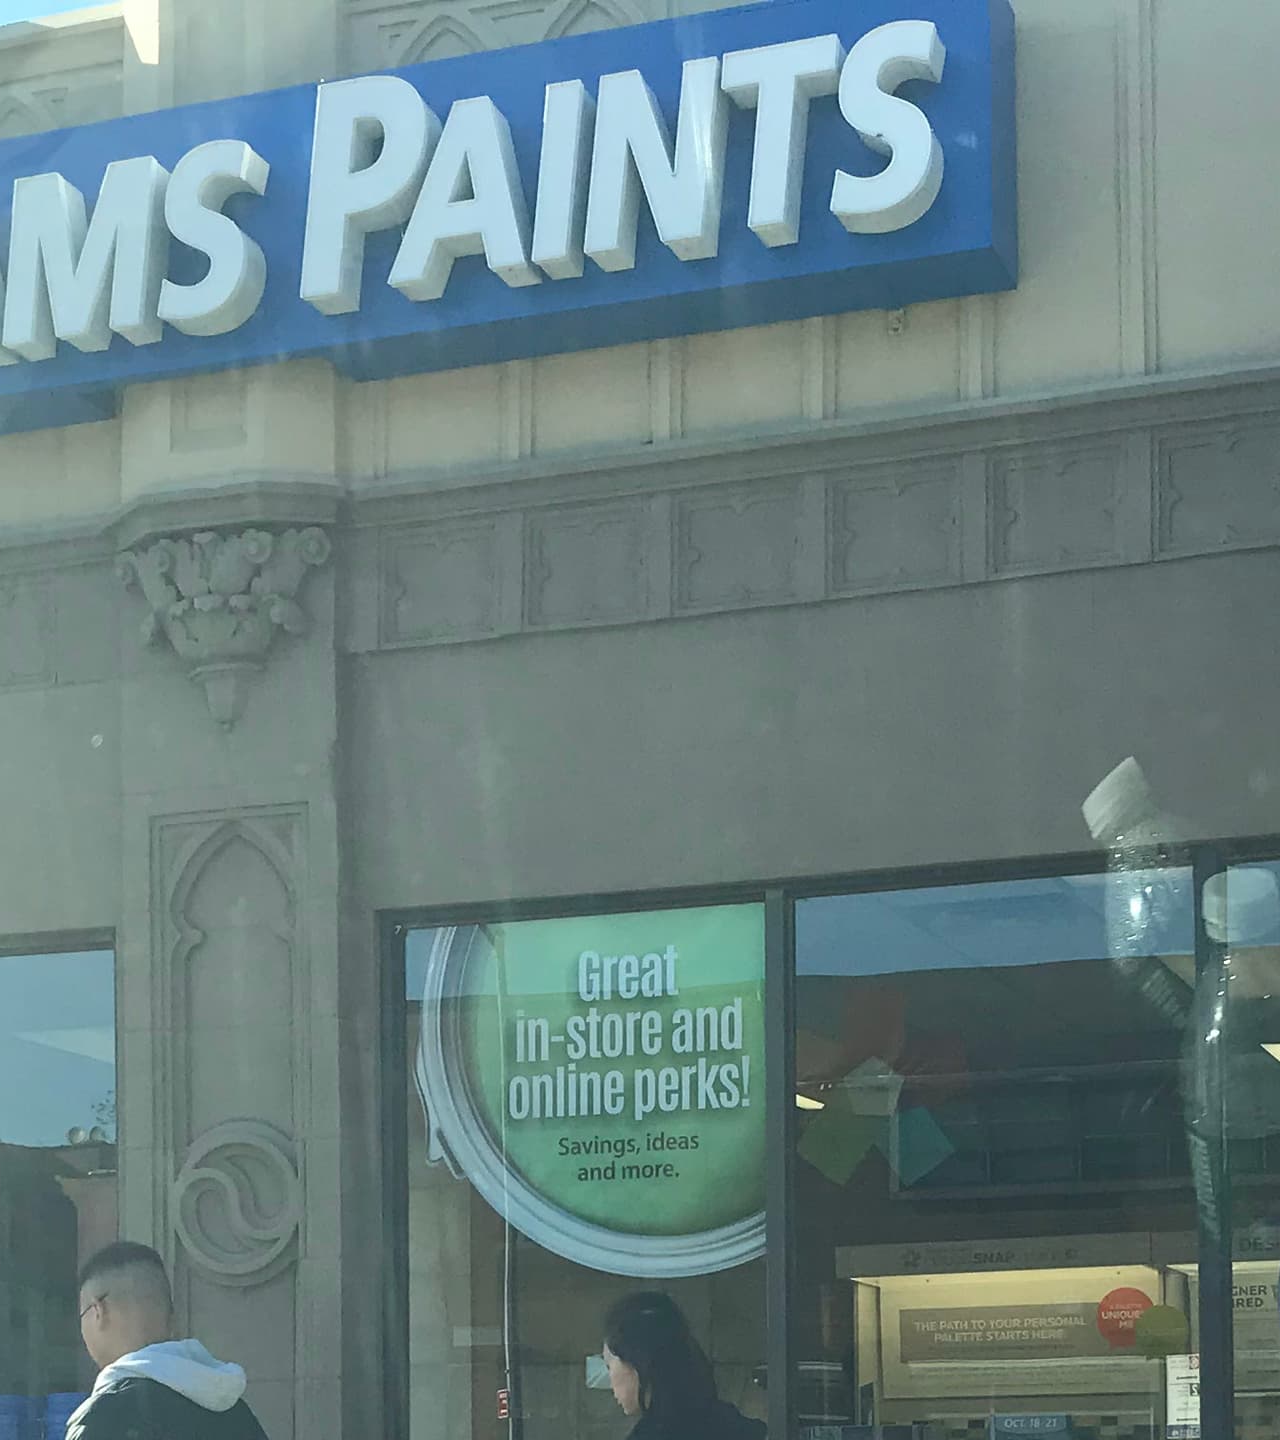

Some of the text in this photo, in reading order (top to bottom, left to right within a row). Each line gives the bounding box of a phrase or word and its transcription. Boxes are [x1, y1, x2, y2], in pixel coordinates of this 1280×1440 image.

[300, 20, 947, 315] PAINTS
[577, 945, 679, 1002] Great
[516, 998, 743, 1063] in-store and
[508, 1055, 751, 1122] online perks!
[557, 1132, 700, 1159] Savings, ideas
[577, 1162, 680, 1182] and more.
[914, 1316, 1087, 1332] THE PATH TO YOUR PERSONAL
[934, 1332, 983, 1343] PALETTE
[986, 1330, 1029, 1341] STARTS
